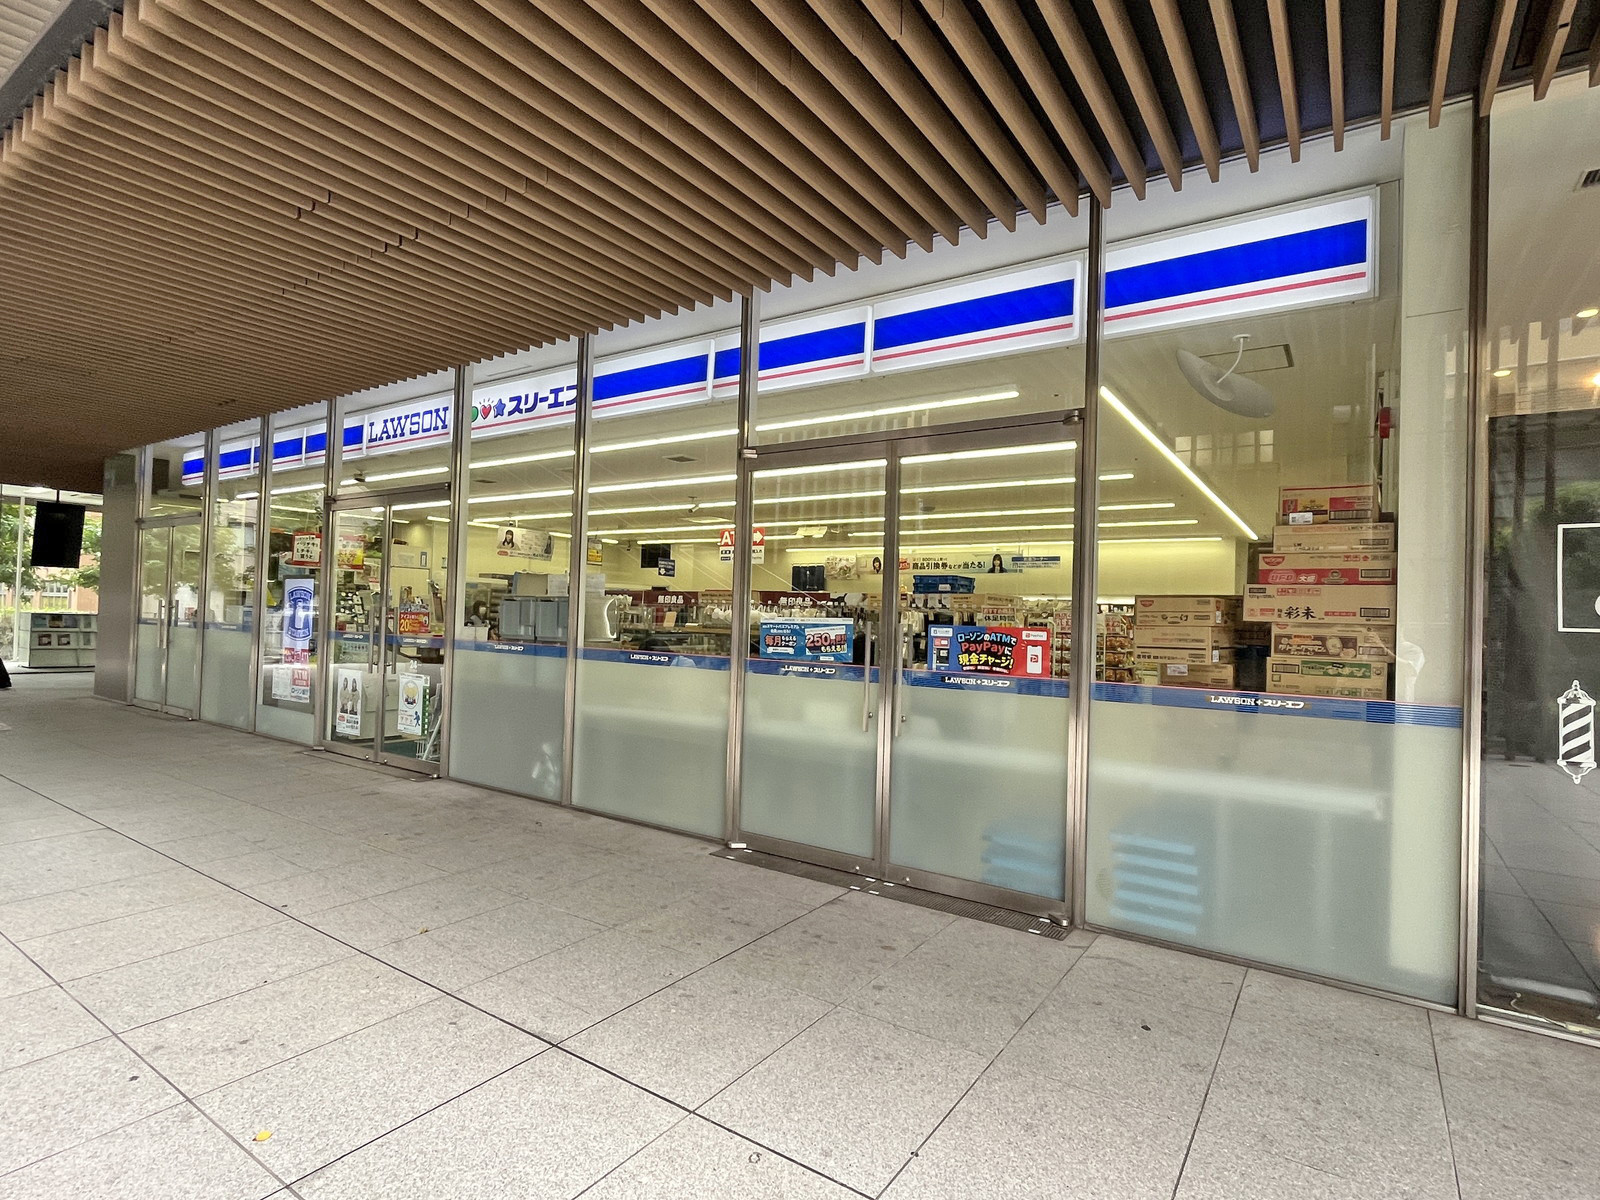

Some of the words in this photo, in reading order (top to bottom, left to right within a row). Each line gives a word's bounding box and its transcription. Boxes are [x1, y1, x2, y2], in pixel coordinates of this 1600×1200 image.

[507, 385, 578, 416] スリーエフ
[368, 406, 449, 442] LAWSON
[721, 530, 735, 546] AT
[1284, 606, 1317, 620] 彩未
[765, 634, 782, 647] 毎月
[957, 632, 1018, 646] ローソンのATMで
[961, 641, 1013, 655] PayPayに
[958, 652, 1014, 669] 現金チャージ!
[945, 676, 977, 685] LAWSON
[981, 679, 1011, 687] スリーエフ
[1211, 695, 1256, 706] LAWSON
[1263, 699, 1305, 709] スリーエフ
